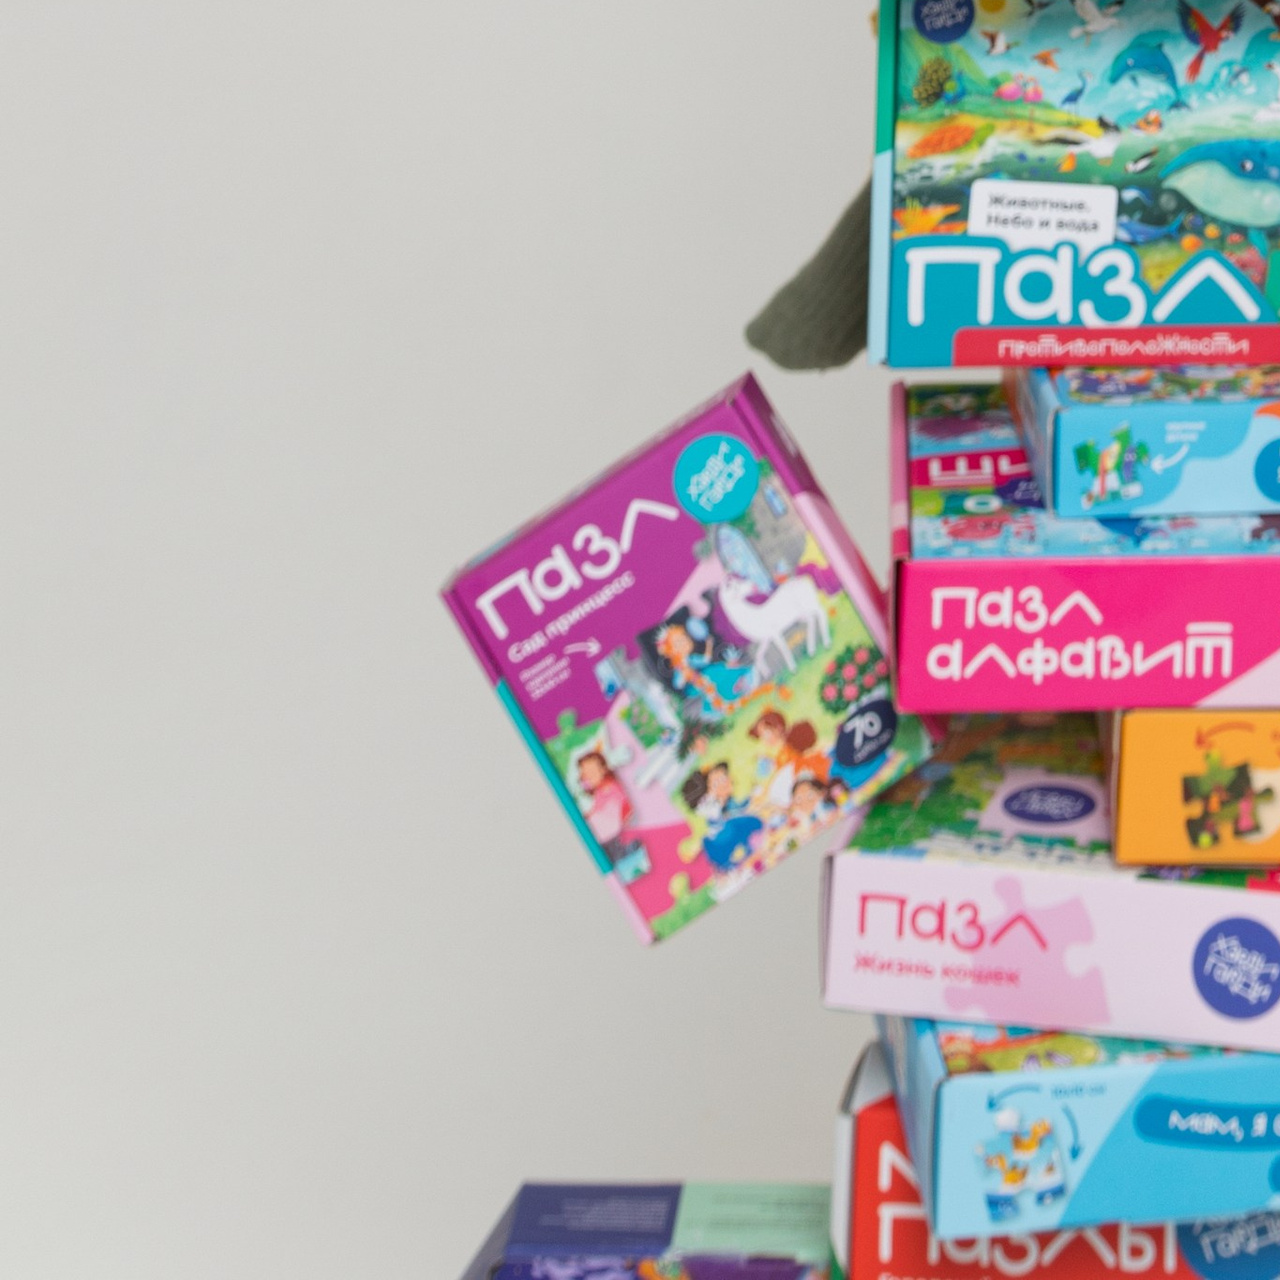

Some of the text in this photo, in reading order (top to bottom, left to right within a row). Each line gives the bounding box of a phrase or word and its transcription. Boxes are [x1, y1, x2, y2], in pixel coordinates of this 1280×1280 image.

[986, 214, 1100, 234] Небо и вода
[507, 631, 549, 663] Сад
[843, 711, 882, 750] 70
[854, 955, 1020, 987] Жизнь кошек
